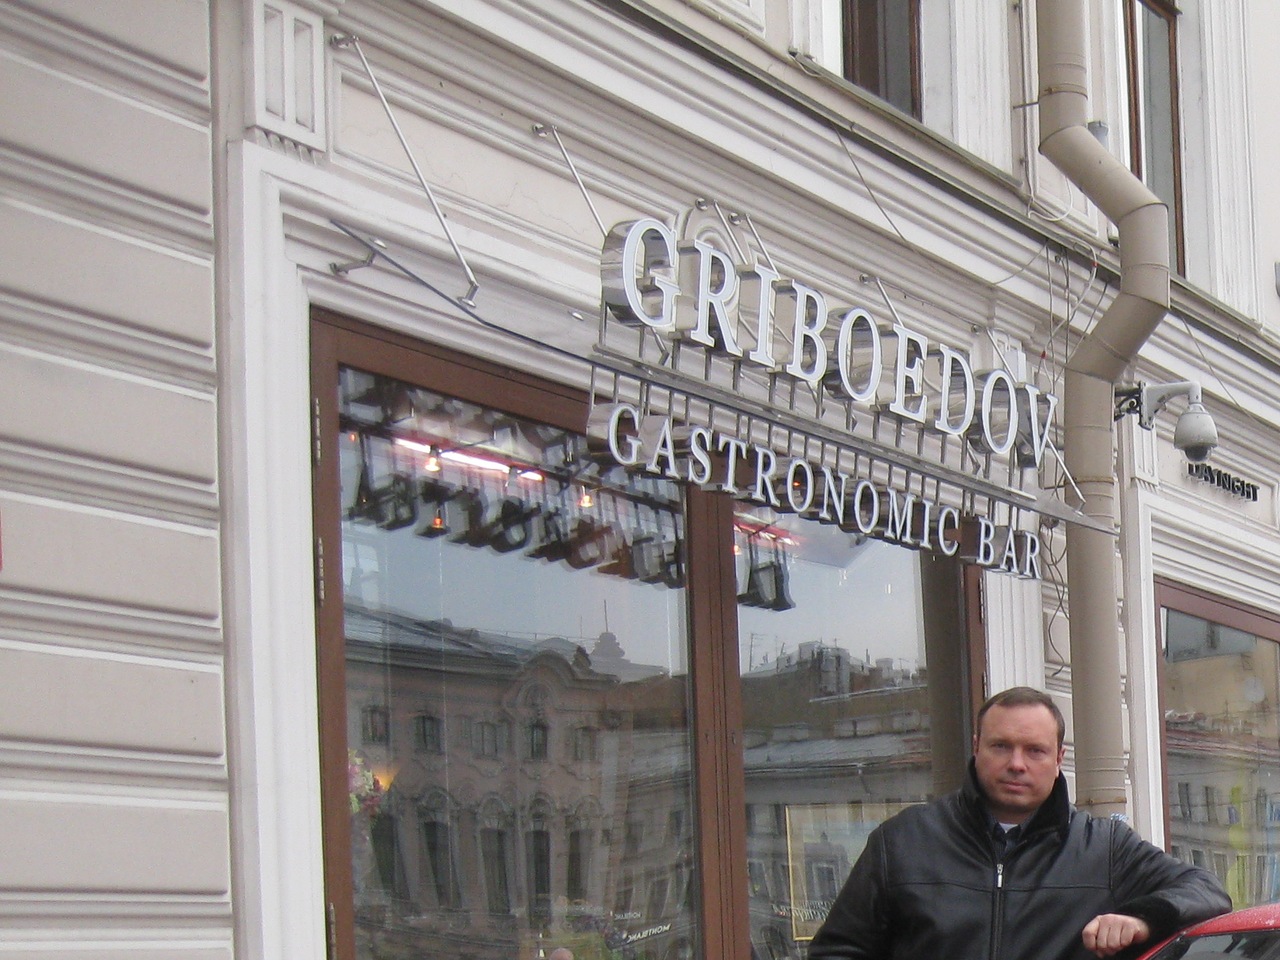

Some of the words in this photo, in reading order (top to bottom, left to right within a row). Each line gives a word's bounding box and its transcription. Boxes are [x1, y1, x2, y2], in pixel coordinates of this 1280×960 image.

[616, 217, 1060, 468] GRIBOEDOV
[605, 403, 961, 557] GASTRONOMIC
[977, 515, 1044, 580] BAR
